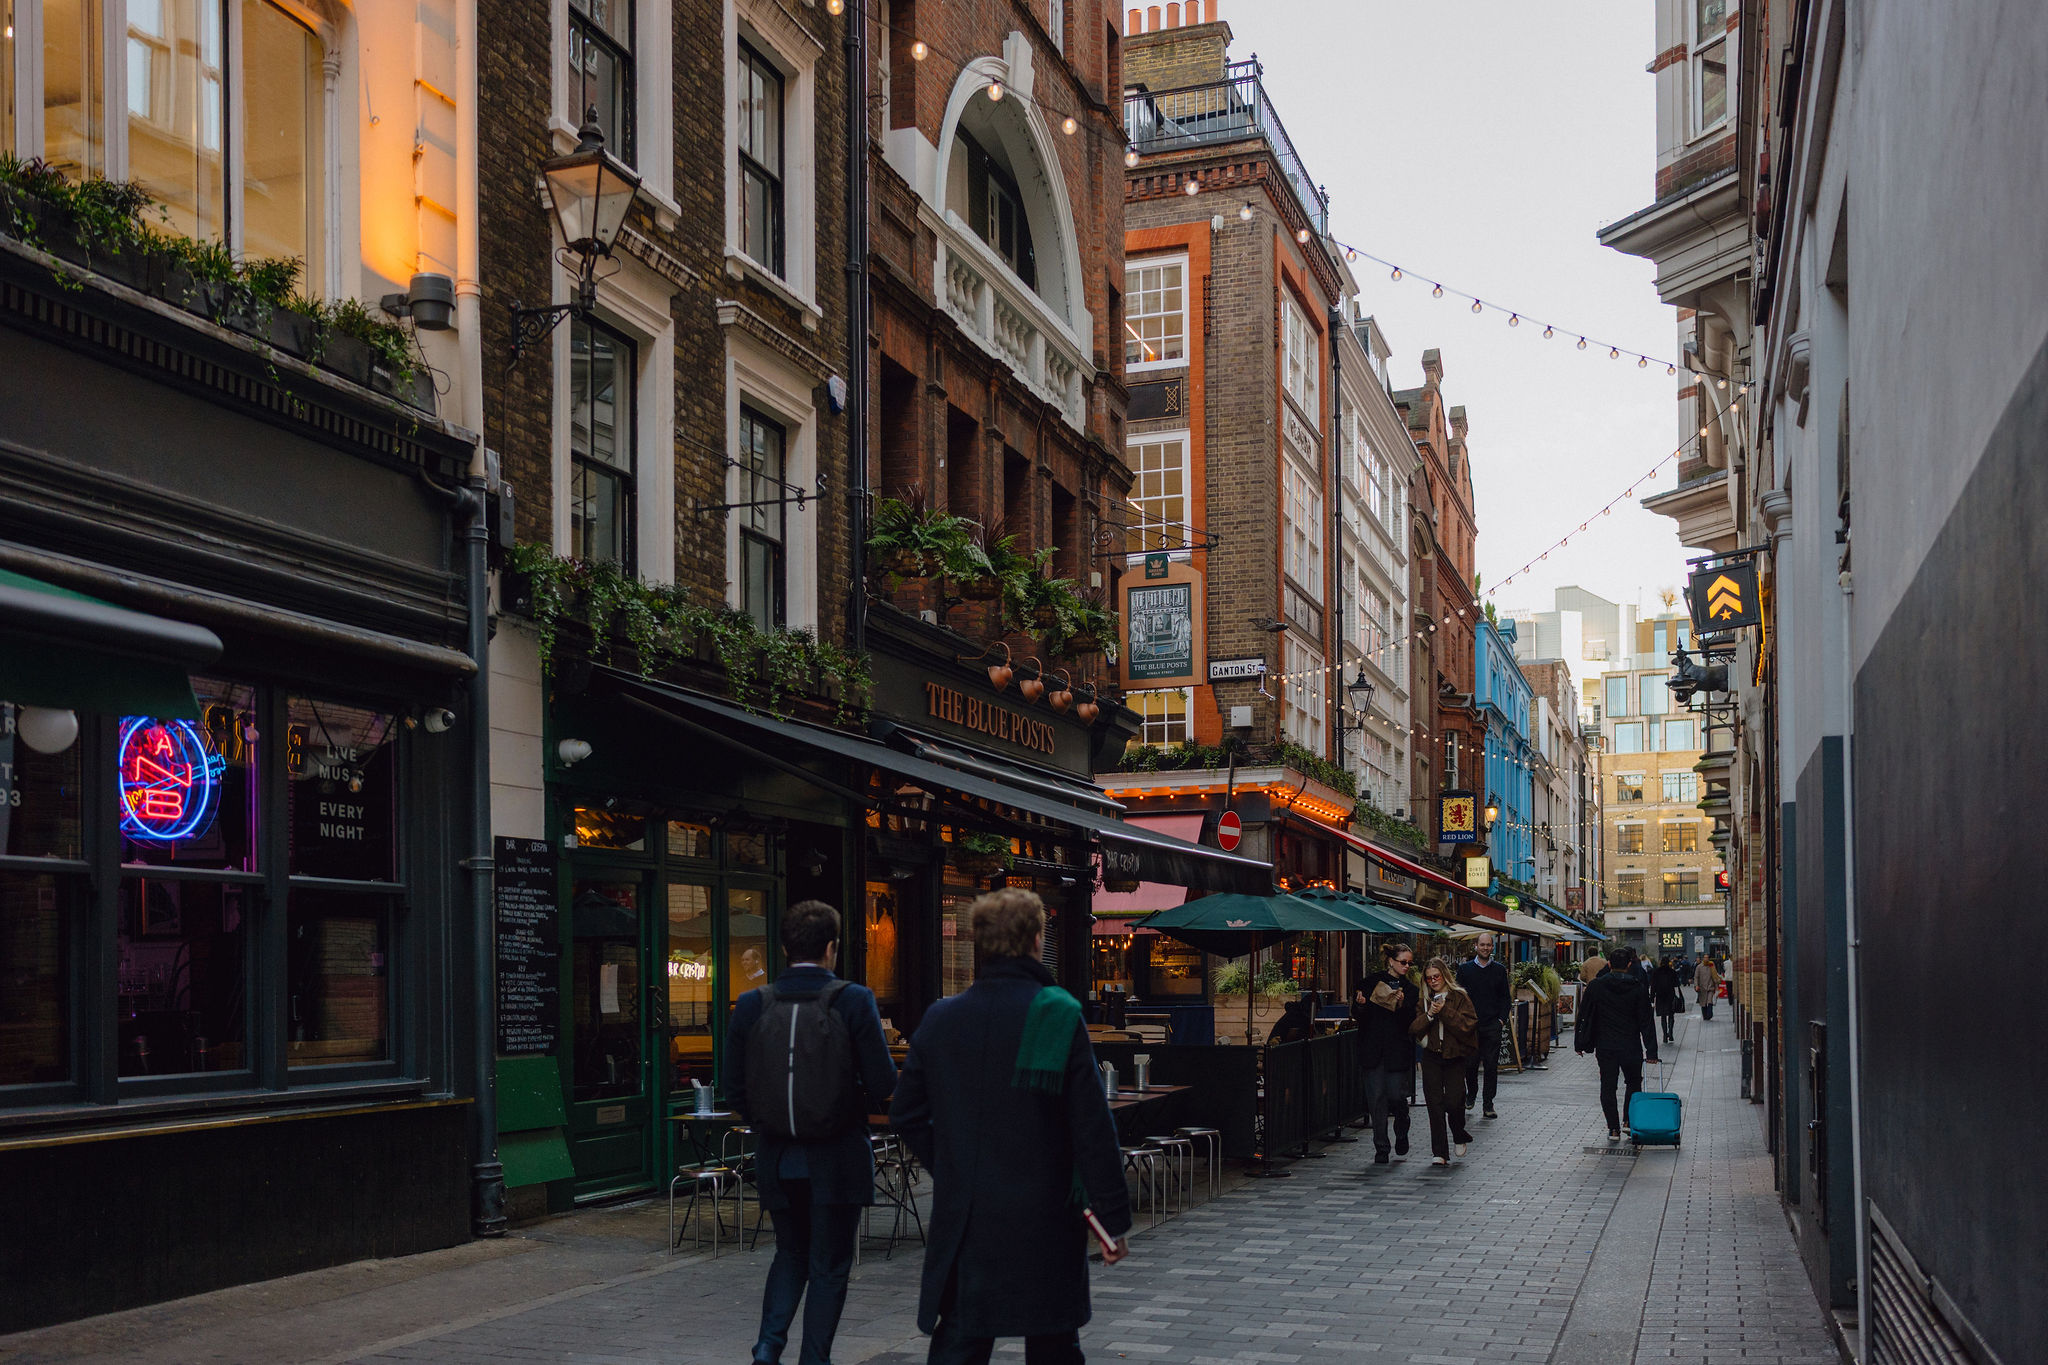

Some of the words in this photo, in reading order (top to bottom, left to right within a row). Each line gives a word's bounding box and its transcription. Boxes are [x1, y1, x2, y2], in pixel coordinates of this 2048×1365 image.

[506, 486, 512, 498] 8
[1148, 662, 1166, 670] BLUE
[1166, 661, 1188, 669] POSTS
[1212, 666, 1246, 677] GANTON
[926, 681, 965, 725] THE
[966, 696, 1009, 739] BLUE
[1010, 711, 1056, 755] POSTS
[326, 744, 358, 763] LIVE
[318, 764, 366, 783] MUSC
[319, 801, 365, 820] EVERY
[319, 822, 365, 841] NIGHT
[505, 839, 516, 851] BAR
[1104, 850, 1119, 869] BAR
[1119, 853, 1141, 876] CRISPIN
